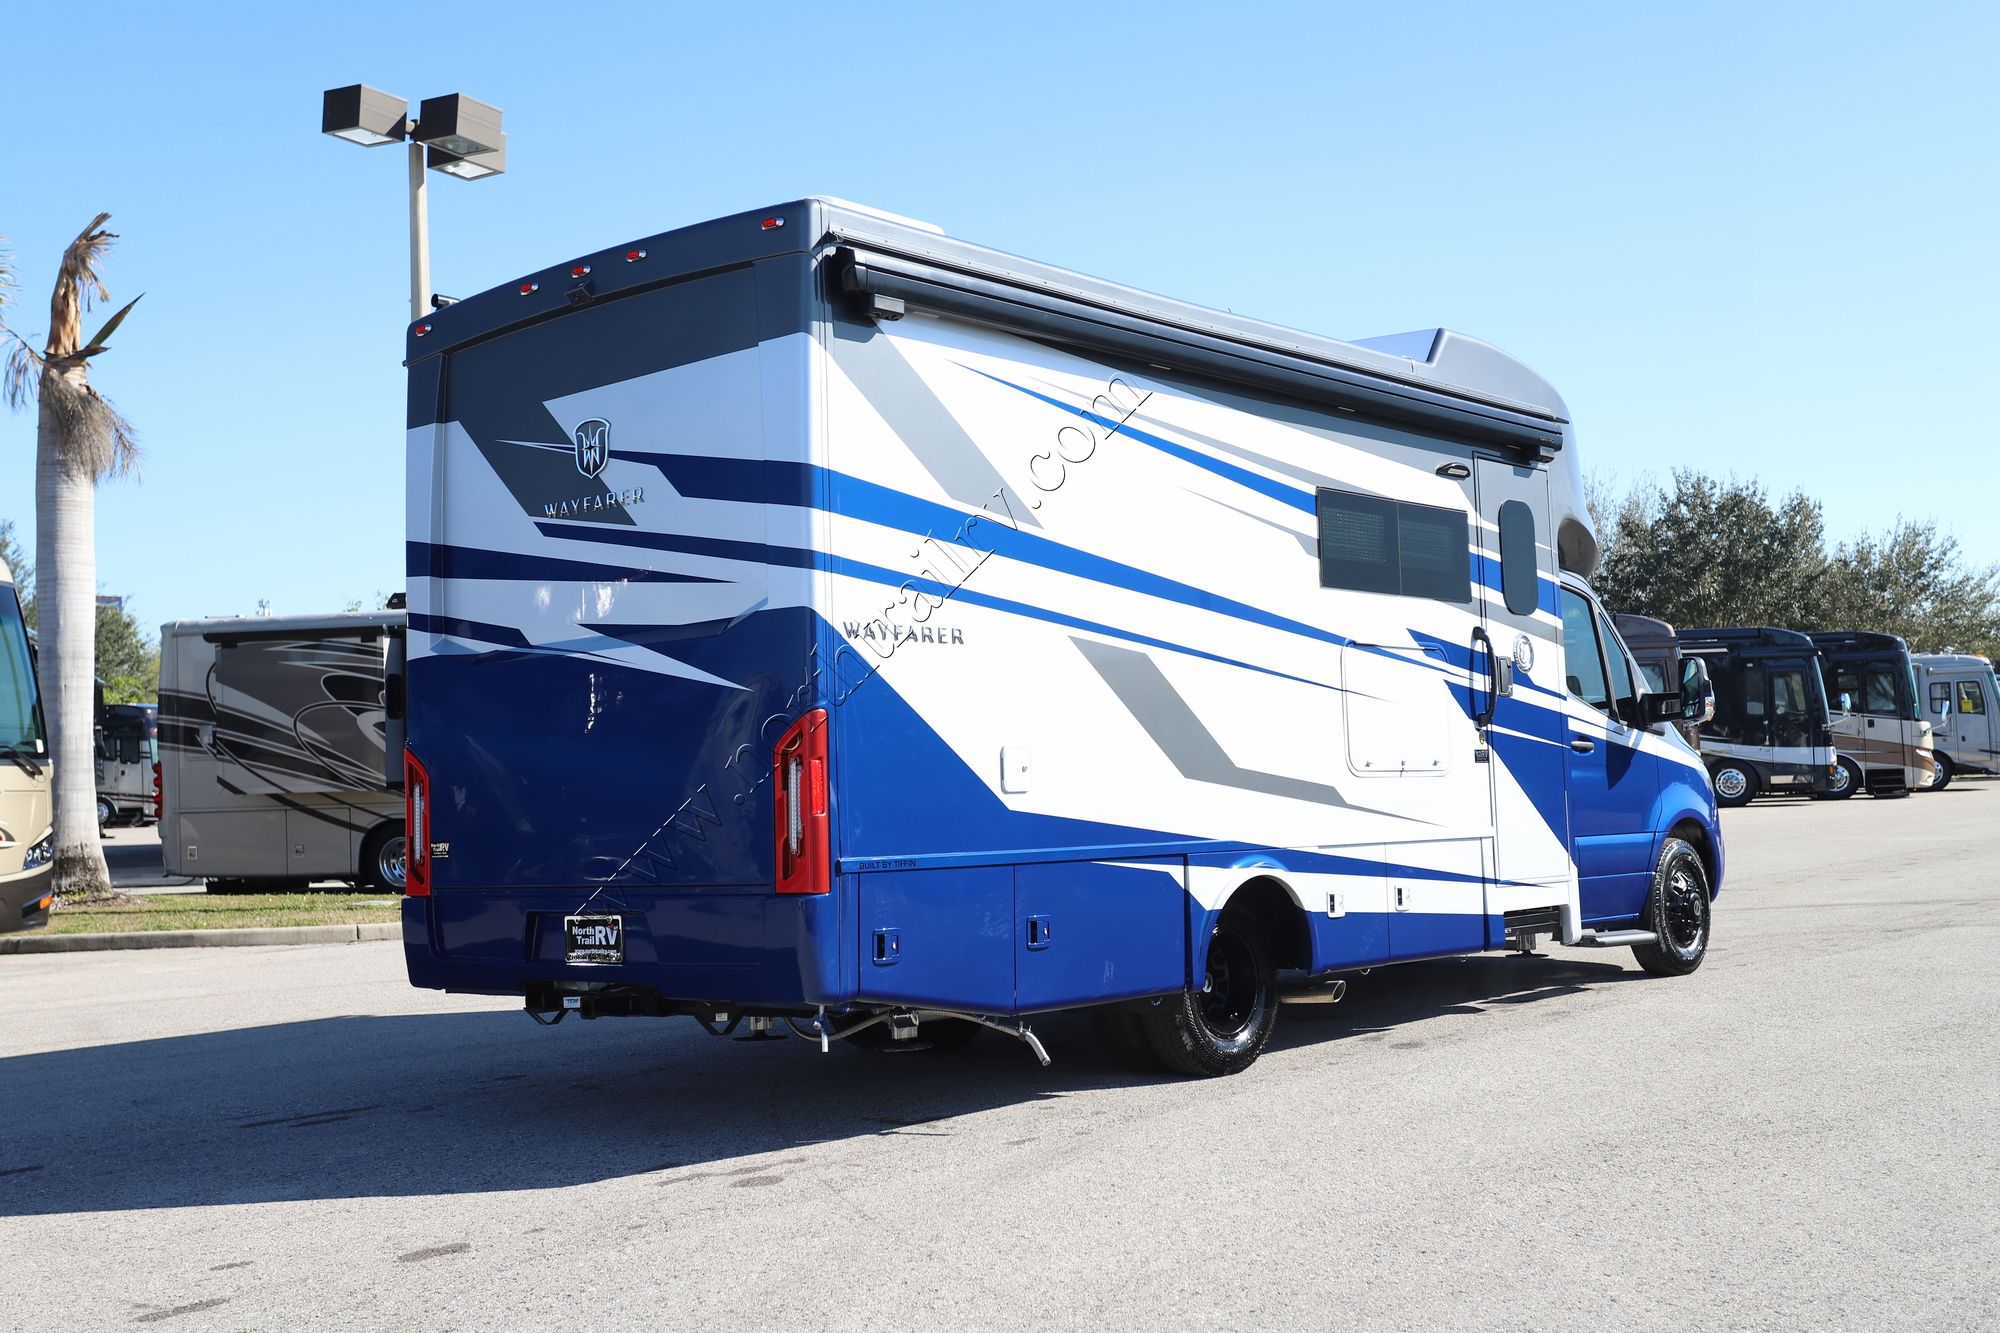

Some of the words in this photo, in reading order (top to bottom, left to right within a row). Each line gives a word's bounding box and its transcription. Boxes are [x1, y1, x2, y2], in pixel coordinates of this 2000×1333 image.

[544, 487, 645, 519] WAYFARER
[843, 621, 964, 645] WAYFARER
[859, 862, 880, 870] BUILT
[882, 861, 892, 869] BY
[894, 860, 916, 868] TIFFIN
[572, 926, 594, 935] North
[595, 926, 617, 945] RV
[576, 936, 594, 945] Trail
